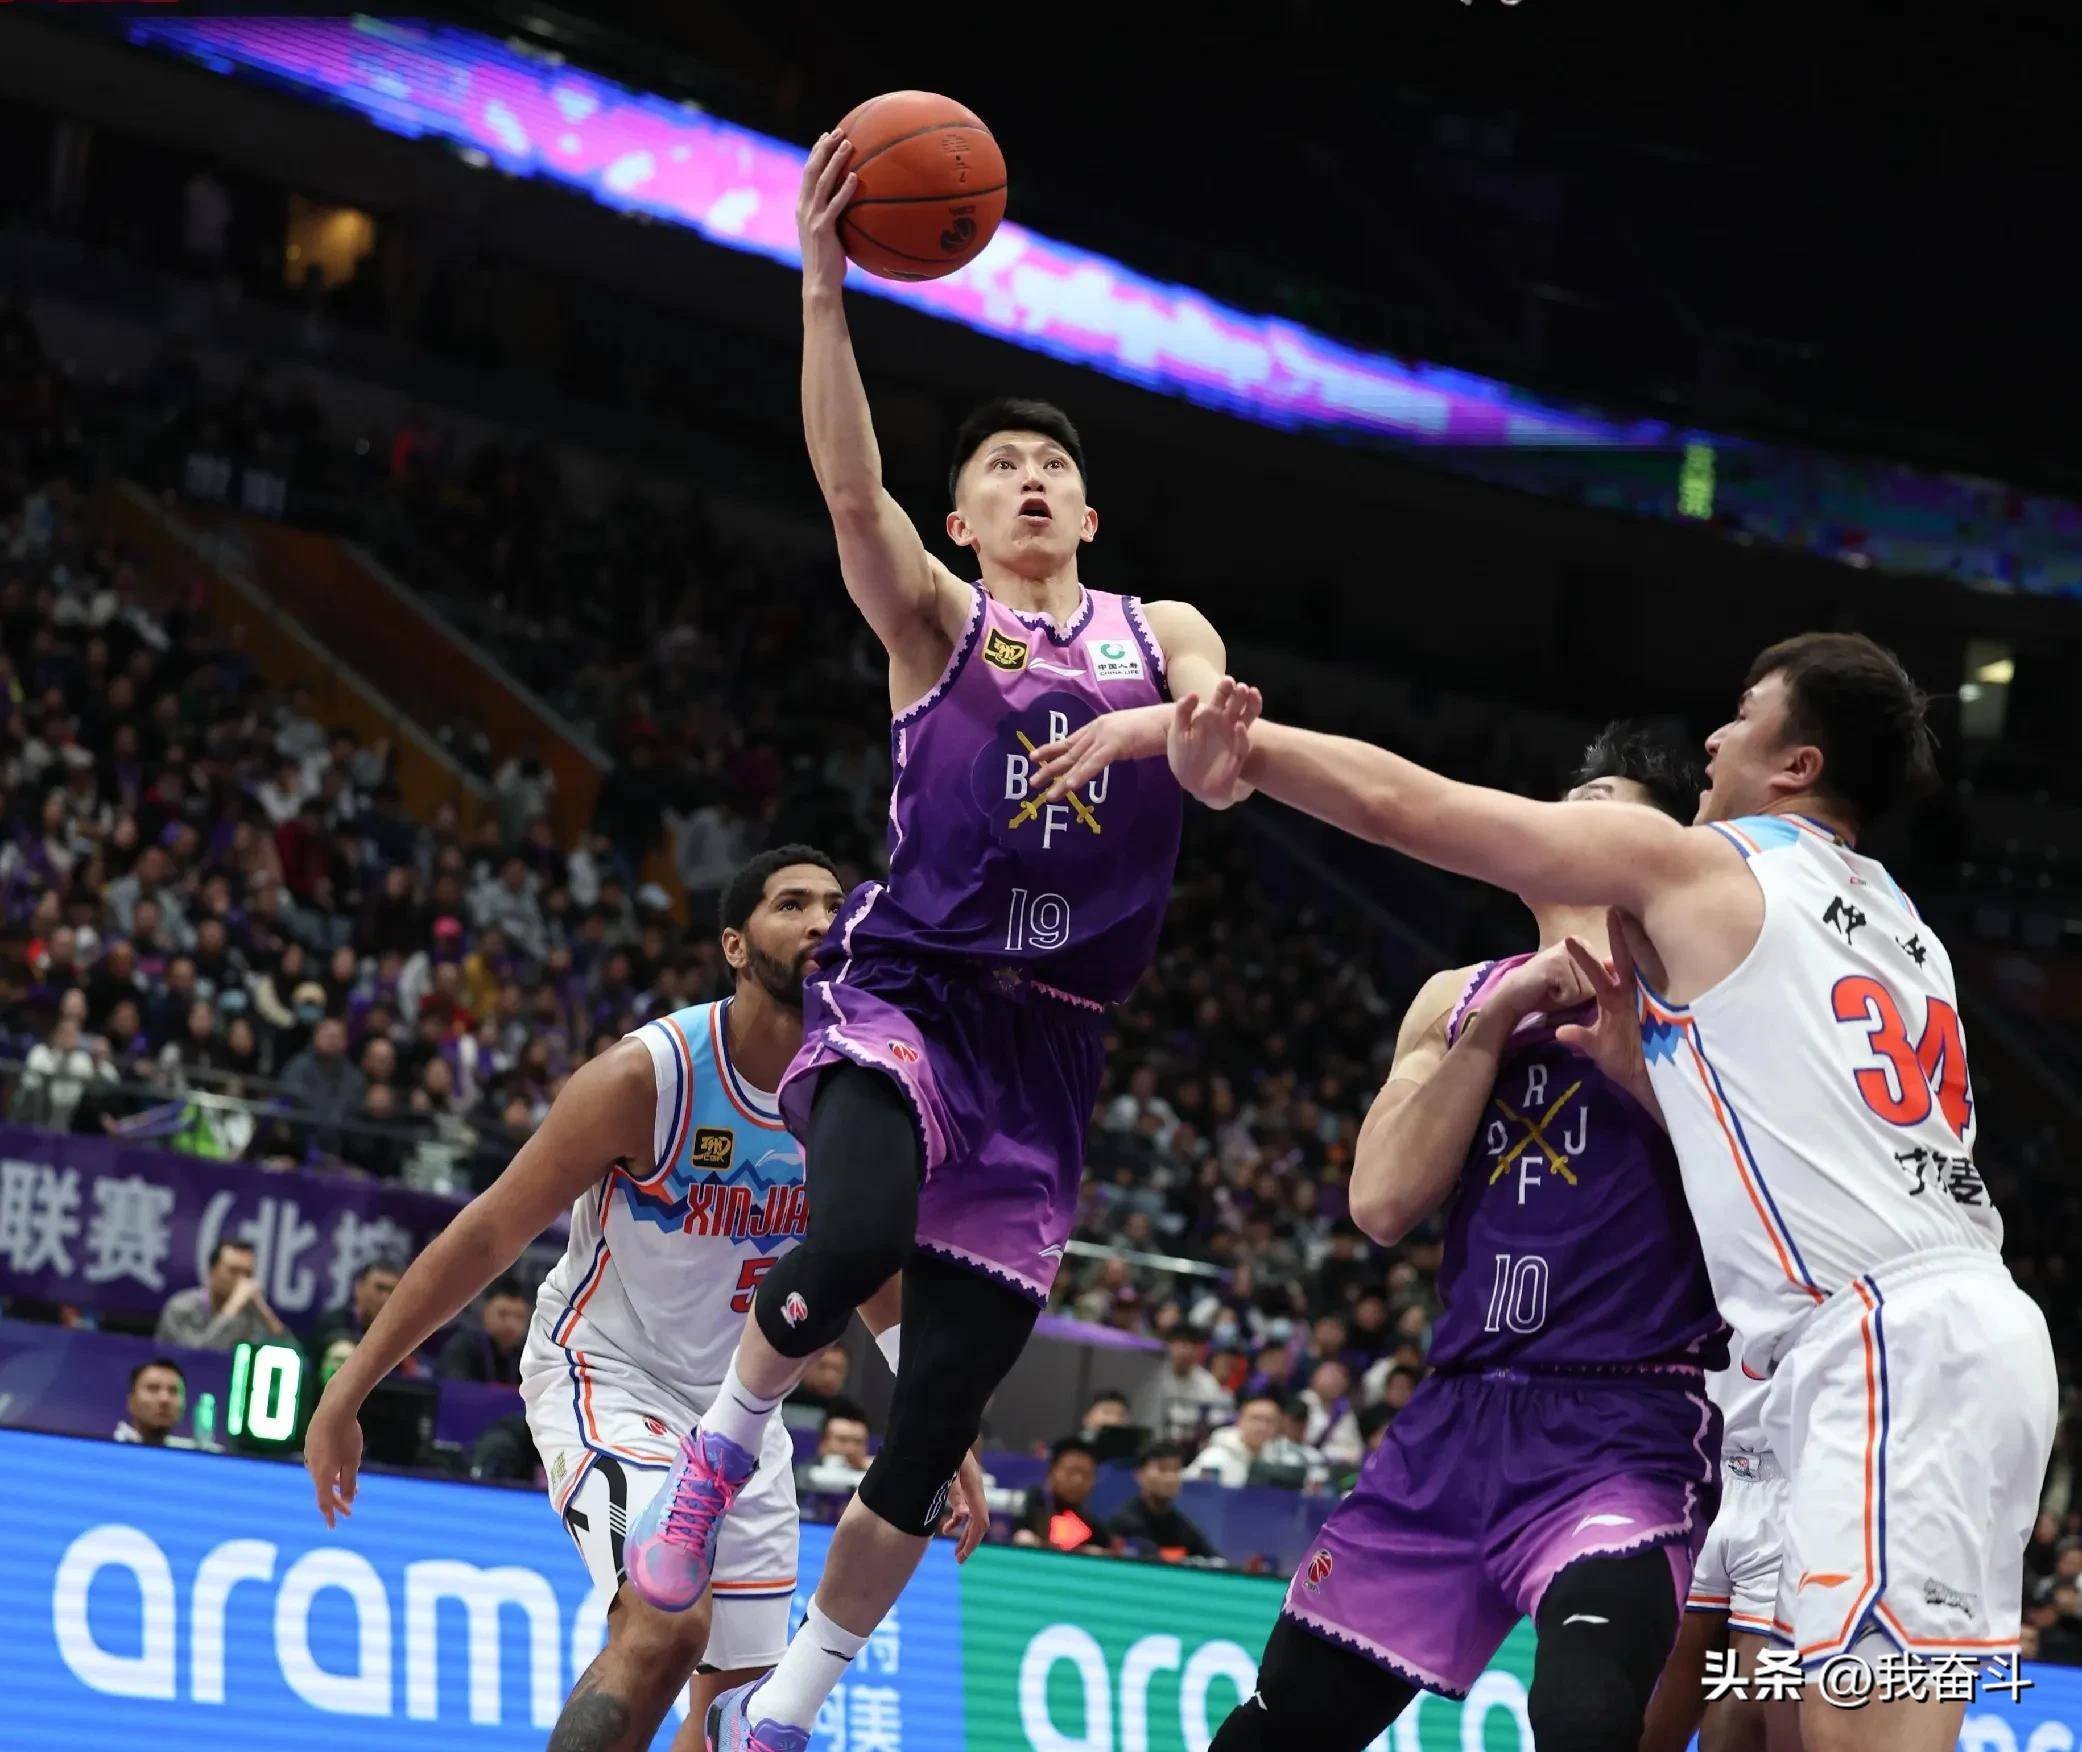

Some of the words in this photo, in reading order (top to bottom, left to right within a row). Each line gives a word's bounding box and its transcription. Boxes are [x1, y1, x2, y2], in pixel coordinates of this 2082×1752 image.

[1004, 753, 1029, 800] B
[1042, 804, 1069, 849] F
[1005, 887, 1070, 950] 19
[1523, 1064, 1548, 1107] R
[1831, 975, 1972, 1143] 34
[1563, 1106, 1588, 1154] J
[1518, 1157, 1543, 1204] F
[1485, 1254, 1549, 1334] 10
[228, 1343, 301, 1441] 10
[52, 1523, 690, 1732] aram
